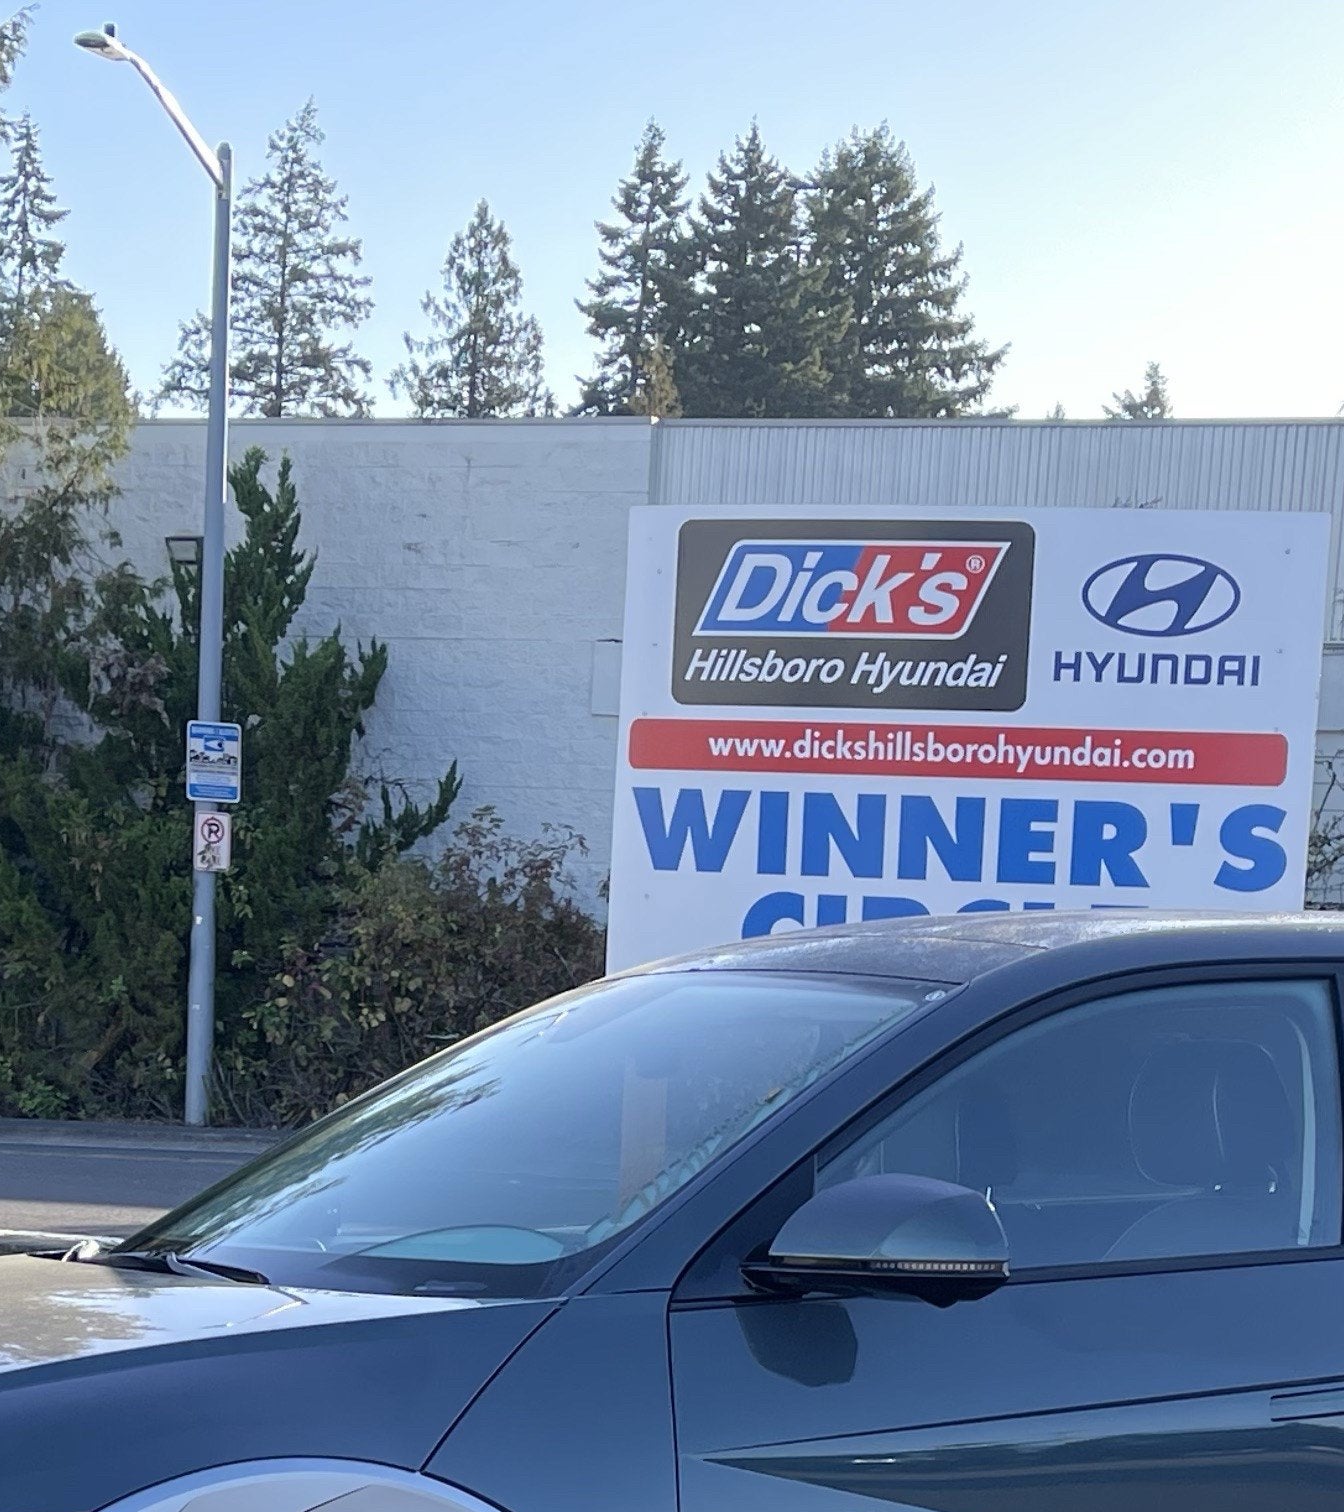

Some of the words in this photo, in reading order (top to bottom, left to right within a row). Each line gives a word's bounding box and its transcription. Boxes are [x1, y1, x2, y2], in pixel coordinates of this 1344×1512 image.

[717, 551, 968, 626] Dick's
[684, 648, 845, 684] Hillsboro
[850, 651, 1009, 694] Hyundai
[1054, 651, 1260, 687] HYUNDAI
[708, 729, 1196, 773] www.dickshillsborohyundai.com
[632, 786, 1288, 893] WINNER'S
